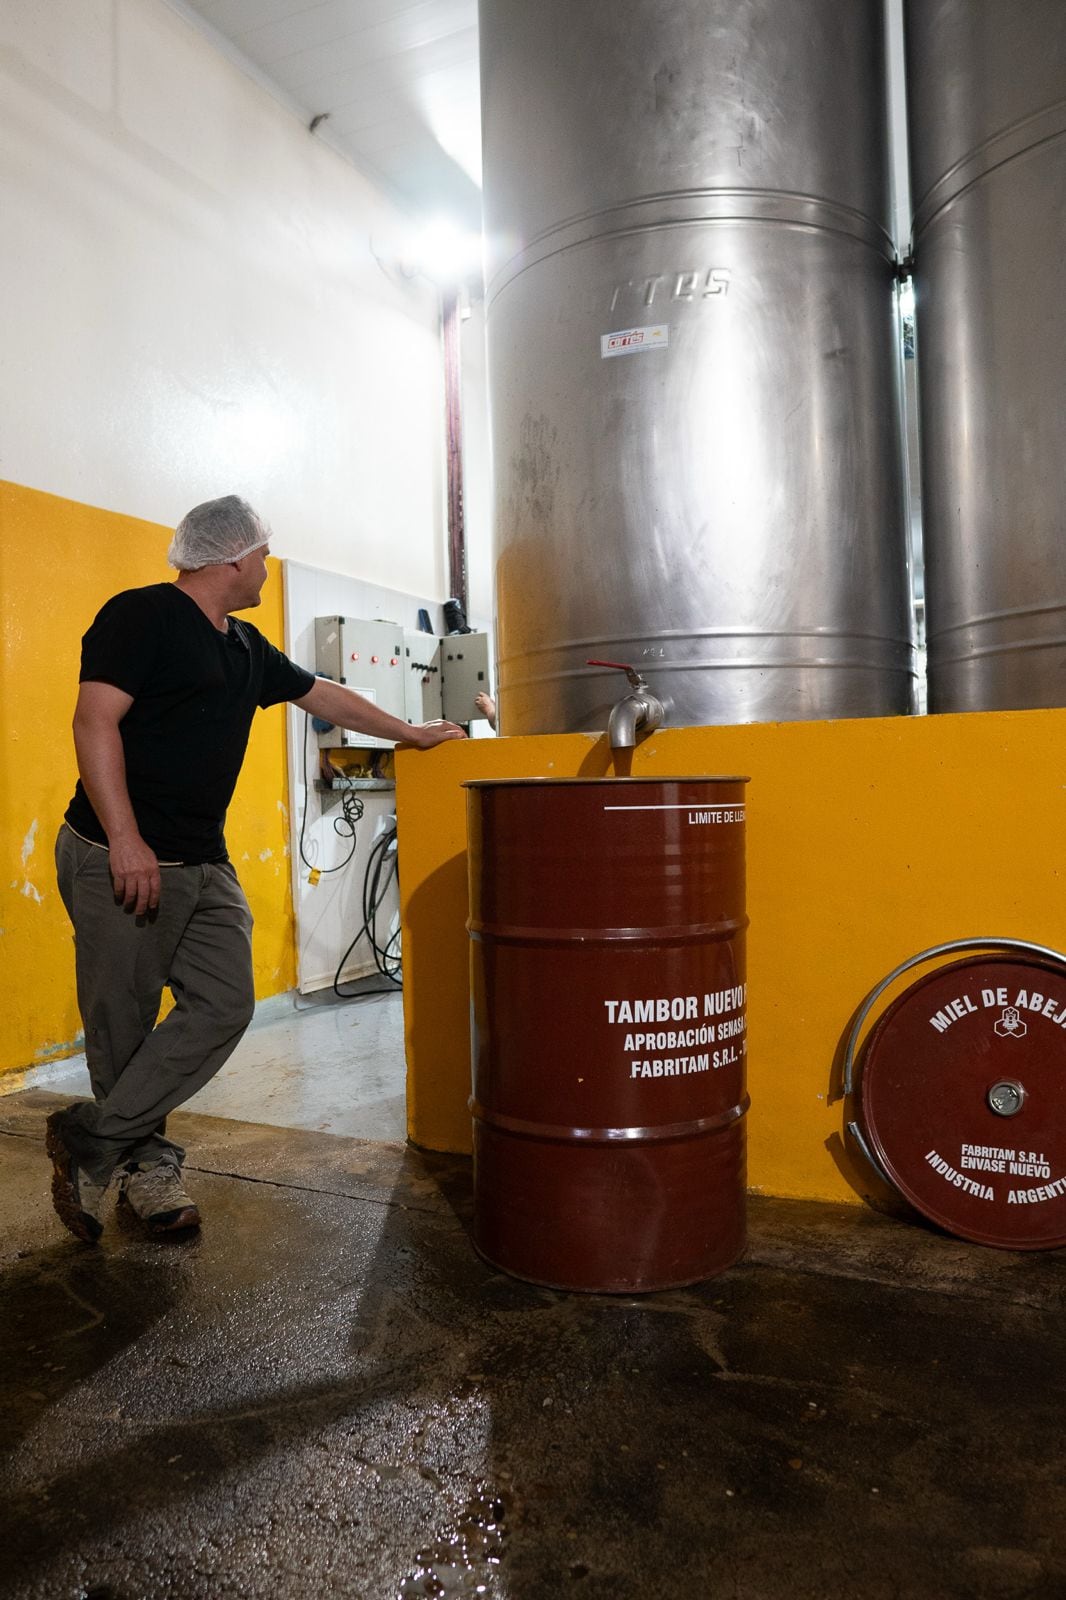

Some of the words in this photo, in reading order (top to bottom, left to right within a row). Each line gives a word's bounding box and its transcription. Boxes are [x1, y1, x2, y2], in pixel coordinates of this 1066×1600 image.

[688, 811, 723, 825] LIMITE
[724, 810, 734, 823] DE
[604, 996, 698, 1024] TAMBOR
[704, 985, 743, 1017] NUEVO
[929, 994, 978, 1033] MIEL
[981, 987, 1009, 1008] DE
[1014, 989, 1066, 1029] ABEJ
[624, 1023, 715, 1052] APROBACIÓN
[631, 1053, 709, 1079] FABRITAM
[712, 1046, 738, 1069] S.R.L.
[961, 1143, 1015, 1161] FABRITAM
[1018, 1151, 1050, 1166] S.R.L.
[961, 1155, 1006, 1173] ENVASE
[1009, 1162, 1051, 1179] NUEVO
[924, 1150, 994, 1201] INDUSTRIA
